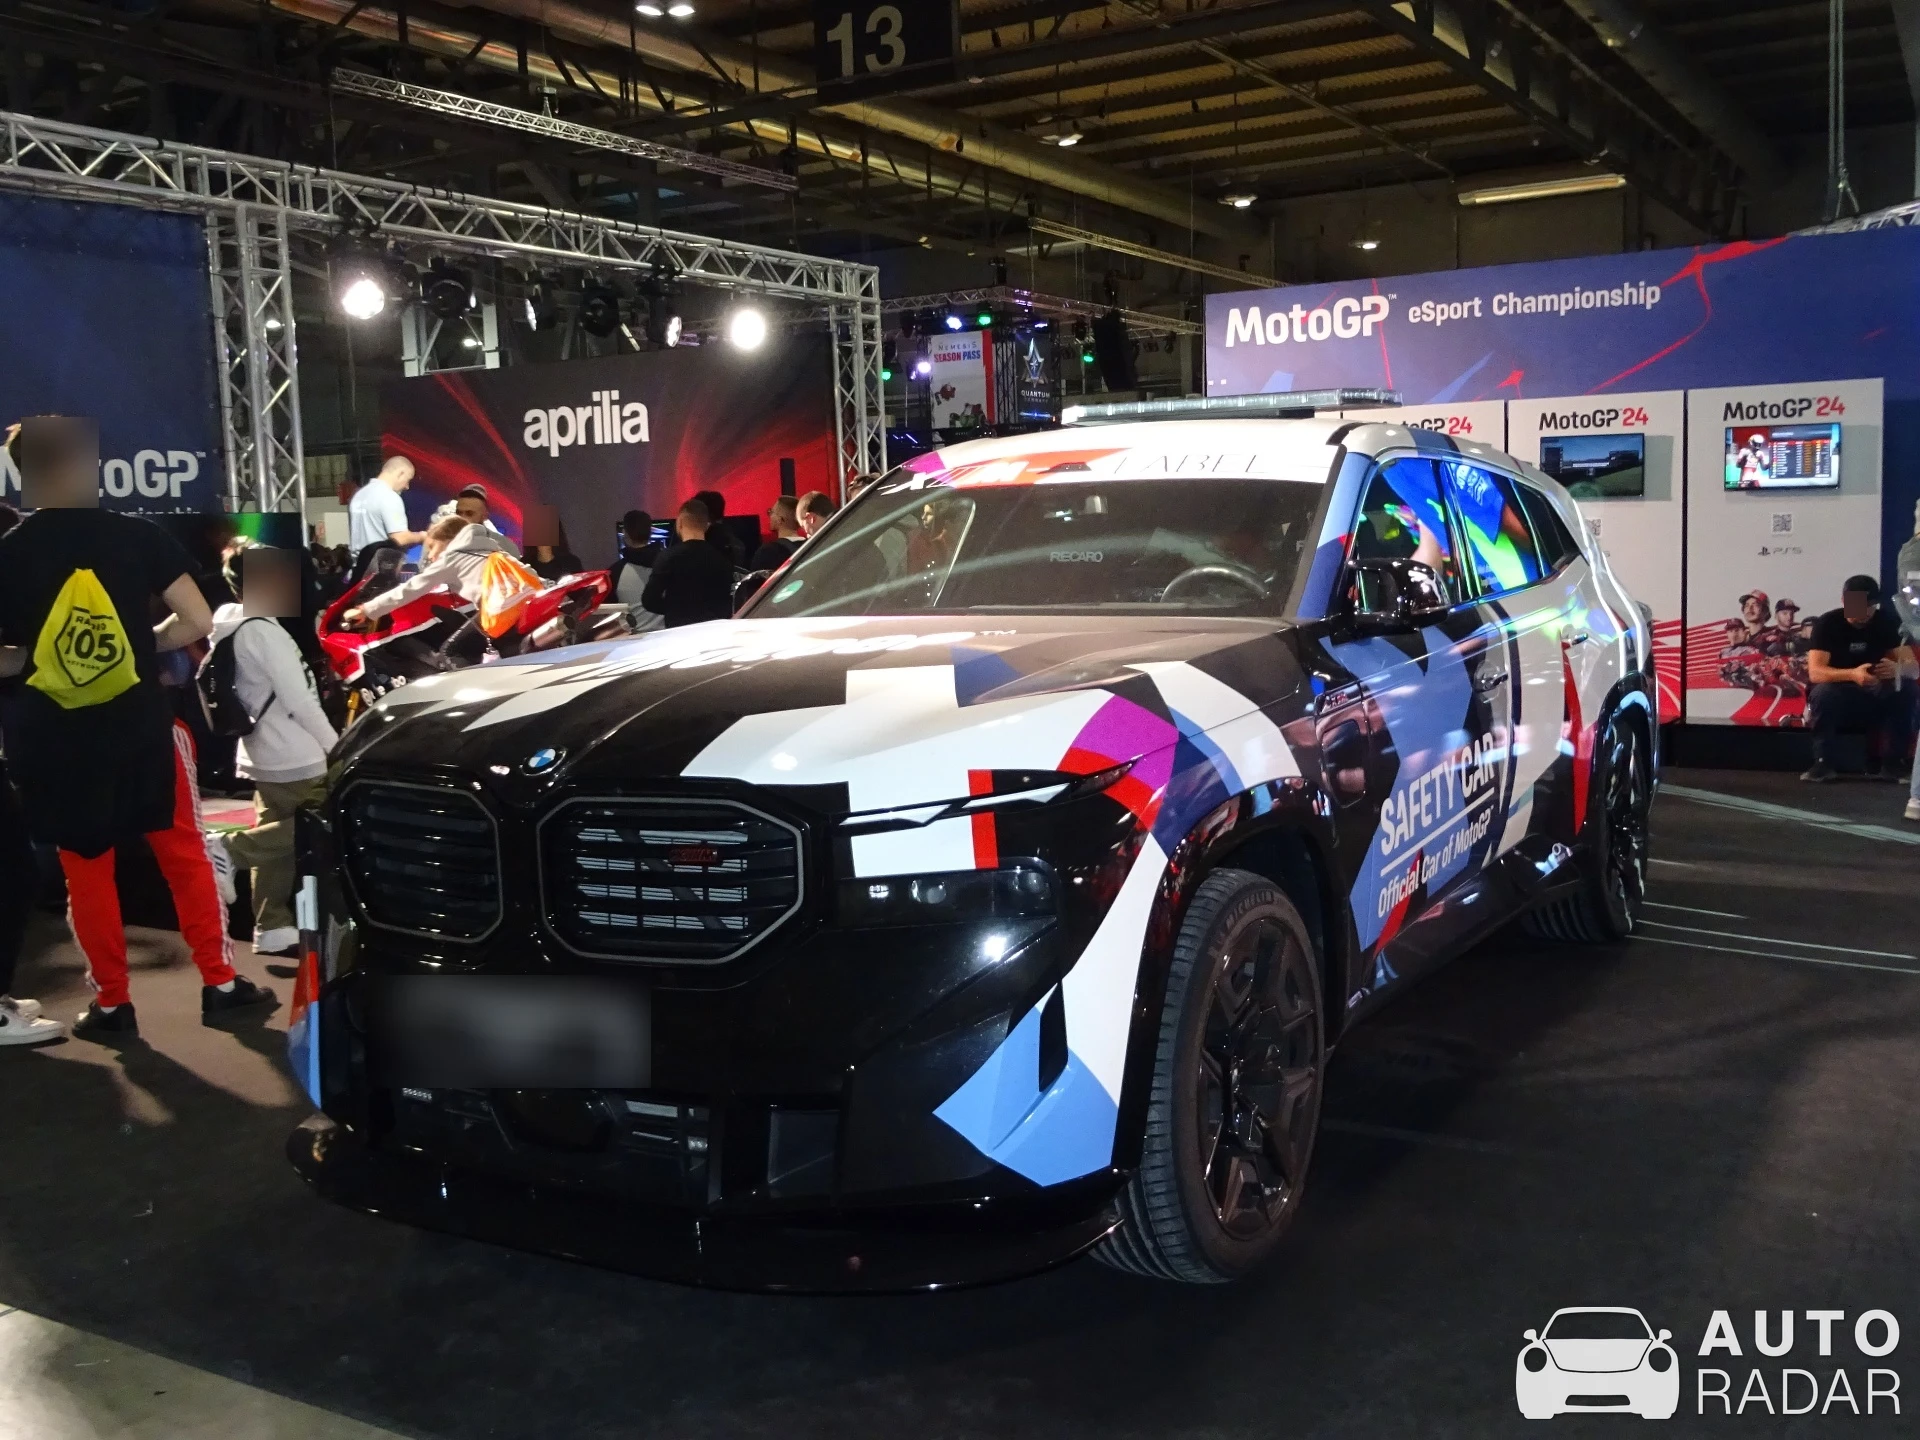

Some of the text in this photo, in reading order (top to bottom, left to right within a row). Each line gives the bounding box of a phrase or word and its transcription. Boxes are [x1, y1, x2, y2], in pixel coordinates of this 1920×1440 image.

[827, 5, 906, 78] 13
[1408, 297, 1482, 326] eSport
[1492, 281, 1661, 317] Championship
[934, 350, 981, 363] SEASON PASS
[1021, 389, 1051, 398] QUANTUM
[1816, 396, 1845, 417] 24
[523, 390, 649, 456] aprilia
[1448, 416, 1473, 434] 24
[1622, 407, 1649, 427] 24
[1050, 551, 1104, 562] RECARO
[65, 626, 117, 662] 105
[1380, 731, 1495, 856] SAFETY CAR
[1377, 859, 1420, 918] Official
[1421, 852, 1441, 884] Car
[1441, 833, 1455, 868] of
[1226, 889, 1275, 930] MICHELIN
